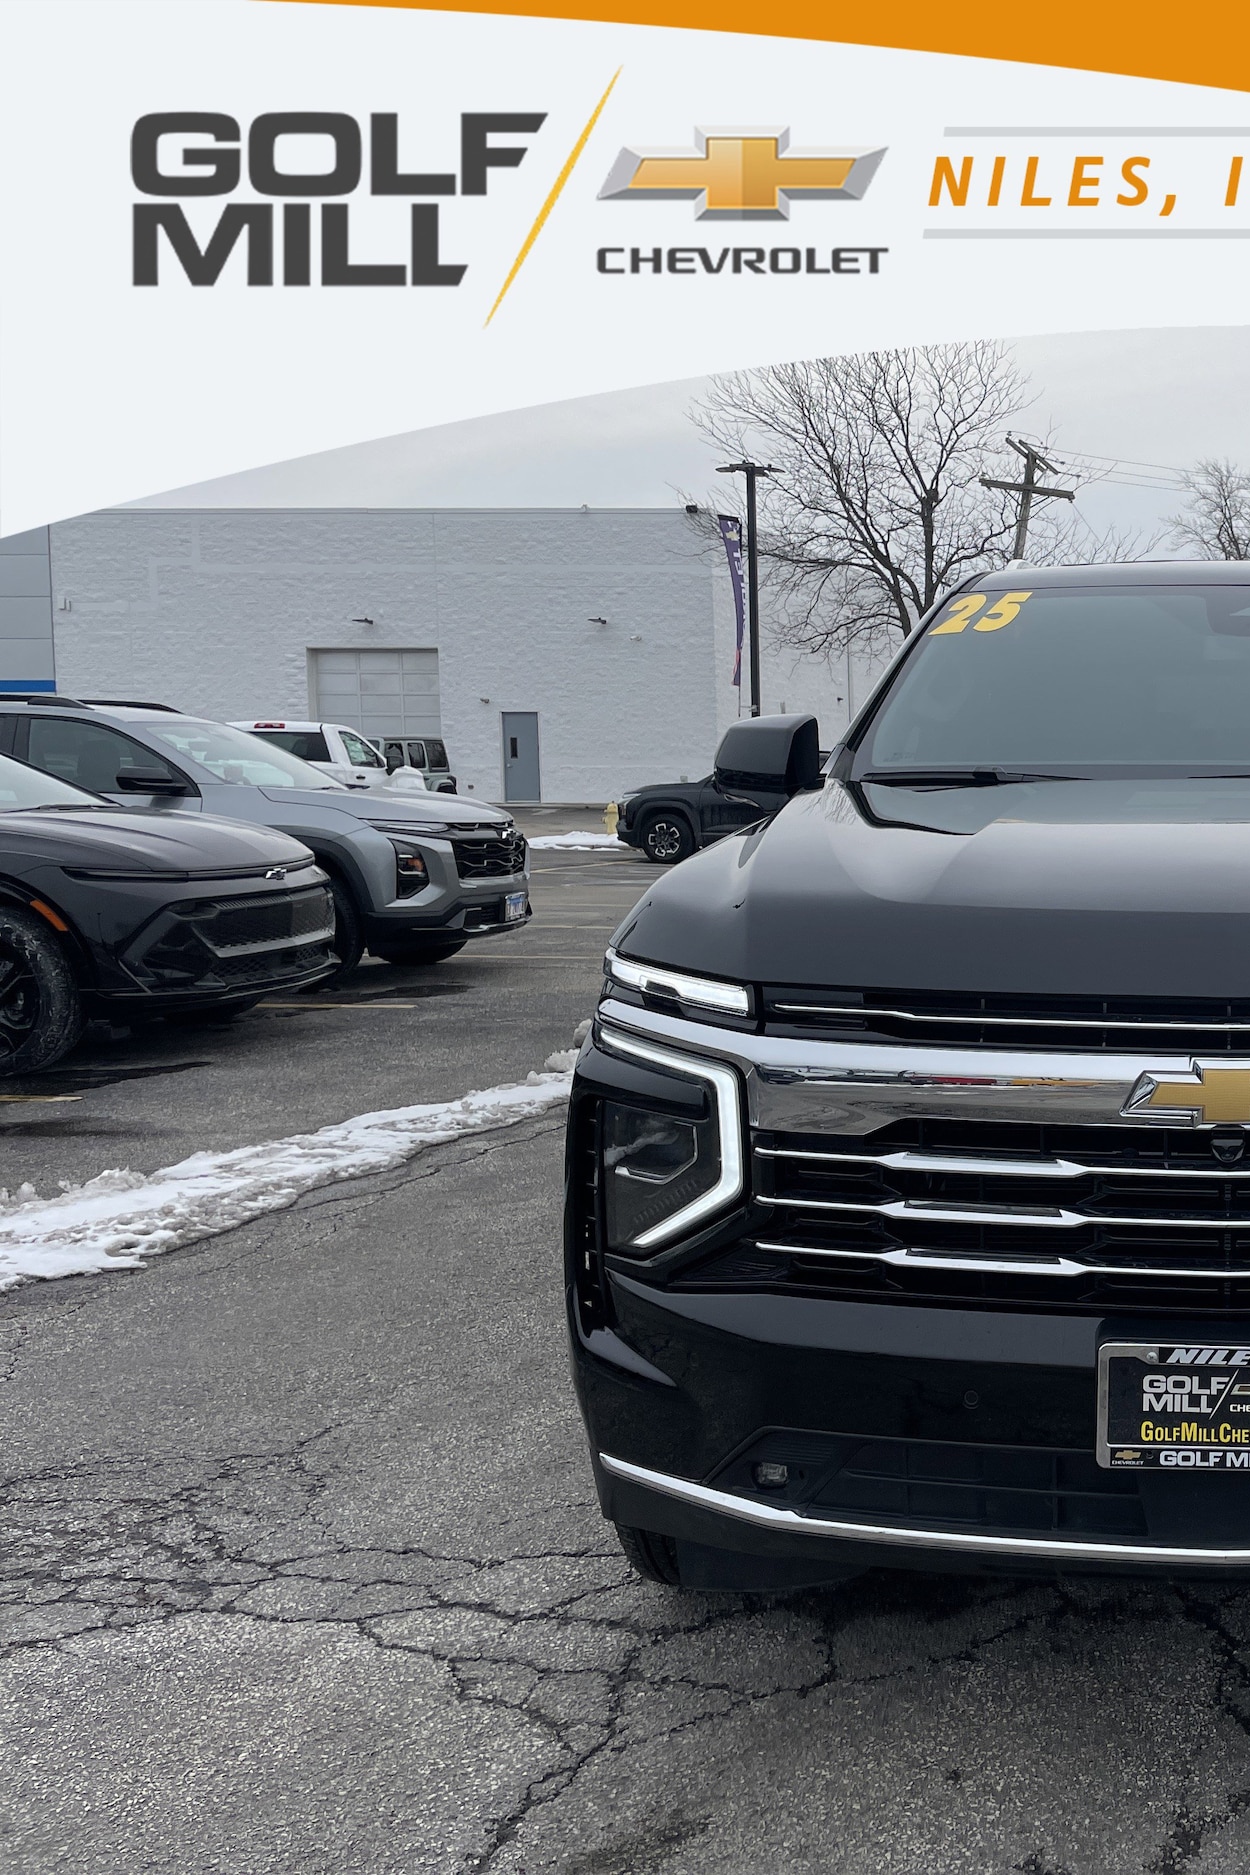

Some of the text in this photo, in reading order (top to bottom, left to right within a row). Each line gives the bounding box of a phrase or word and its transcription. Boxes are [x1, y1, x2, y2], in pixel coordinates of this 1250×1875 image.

[928, 591, 1033, 636] 25
[1142, 1374, 1230, 1395] GOLF
[1142, 1393, 1213, 1414] MILL
[1159, 1450, 1223, 1468] GOLF
